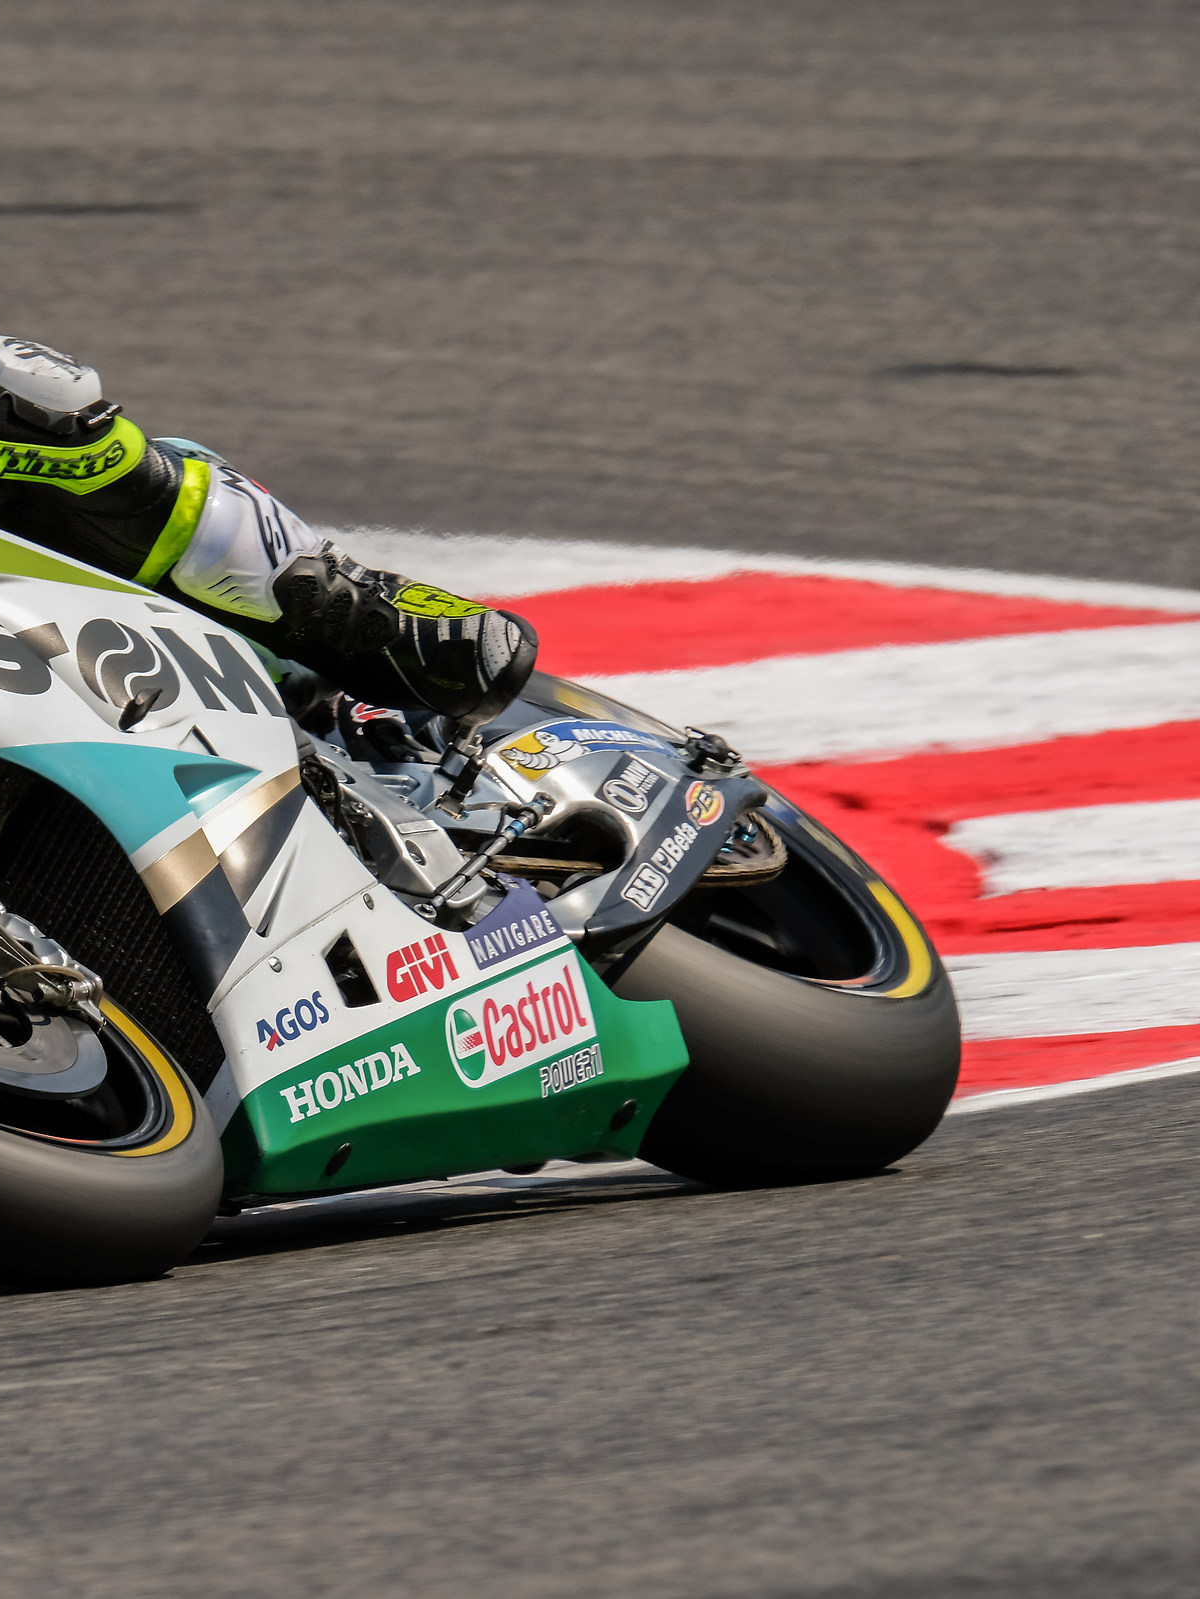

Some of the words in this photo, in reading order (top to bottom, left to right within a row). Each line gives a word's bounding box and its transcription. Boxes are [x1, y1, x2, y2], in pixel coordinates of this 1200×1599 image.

[661, 822, 699, 862] Beta
[386, 932, 460, 1003] GIVI
[470, 909, 557, 964] NAVIGARE
[256, 990, 330, 1051] AGOS
[483, 964, 587, 1067] Castrol
[280, 1043, 421, 1124] HONDA
